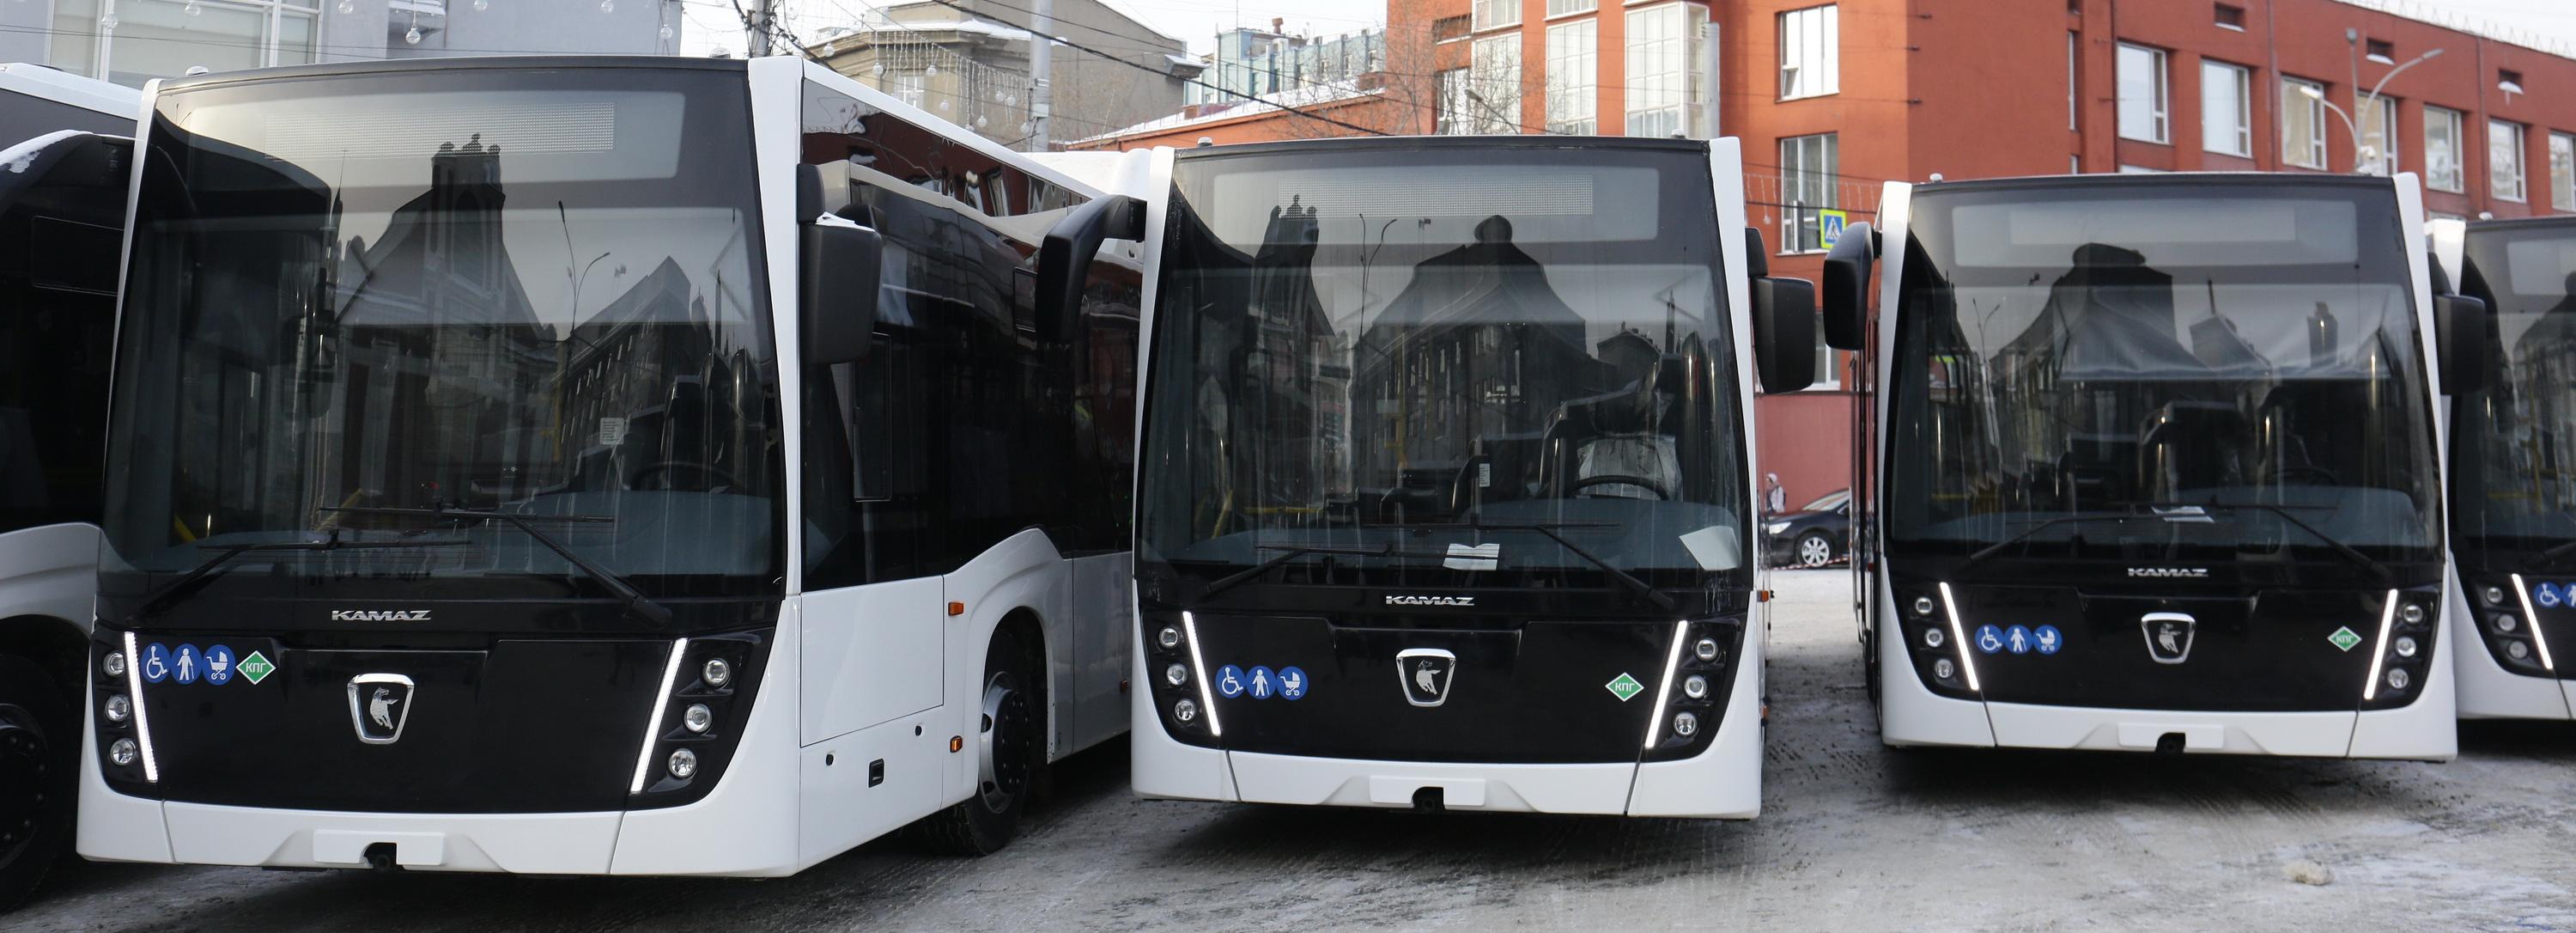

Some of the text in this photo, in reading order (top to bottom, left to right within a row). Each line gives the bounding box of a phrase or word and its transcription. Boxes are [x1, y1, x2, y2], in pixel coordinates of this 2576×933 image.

[2128, 568, 2208, 577] KAMAZ
[1386, 595, 1474, 606] KAMAZ
[331, 610, 431, 620] KAMAZ
[246, 662, 266, 673] КПГ
[1615, 682, 1635, 692] КПГ
